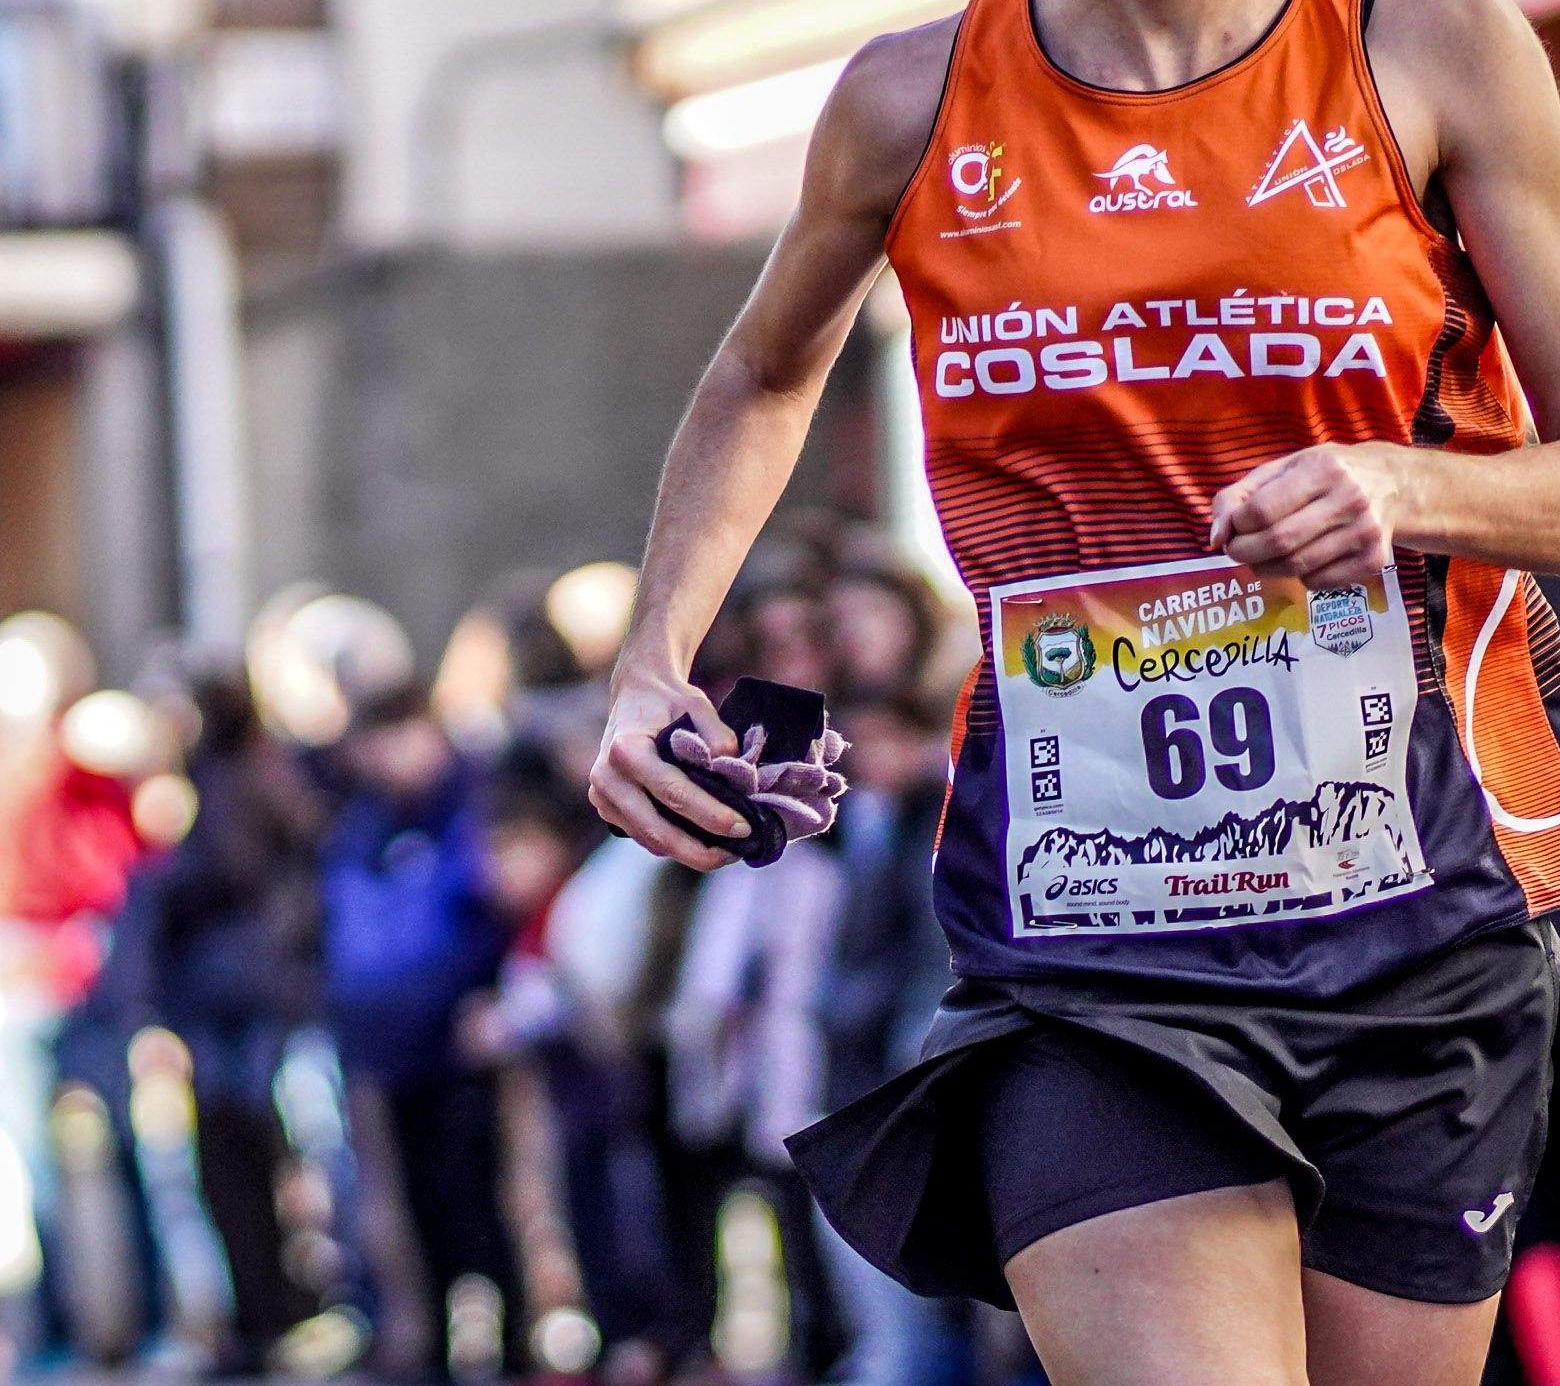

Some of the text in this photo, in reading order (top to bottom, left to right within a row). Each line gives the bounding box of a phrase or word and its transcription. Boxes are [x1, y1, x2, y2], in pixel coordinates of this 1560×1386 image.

[940, 288, 1394, 344] UNIÓN ATLÉTICA
[936, 333, 1389, 397] COSLADA
[1138, 578, 1263, 622] CARRERA DE
[1140, 595, 1266, 649] NAVIDAD
[1316, 615, 1365, 639] 7 PICOS
[1326, 626, 1367, 641] Cercedilla
[1140, 686, 1276, 801] 69
[1068, 877, 1119, 896] asics
[1165, 870, 1290, 897] Trail Run
